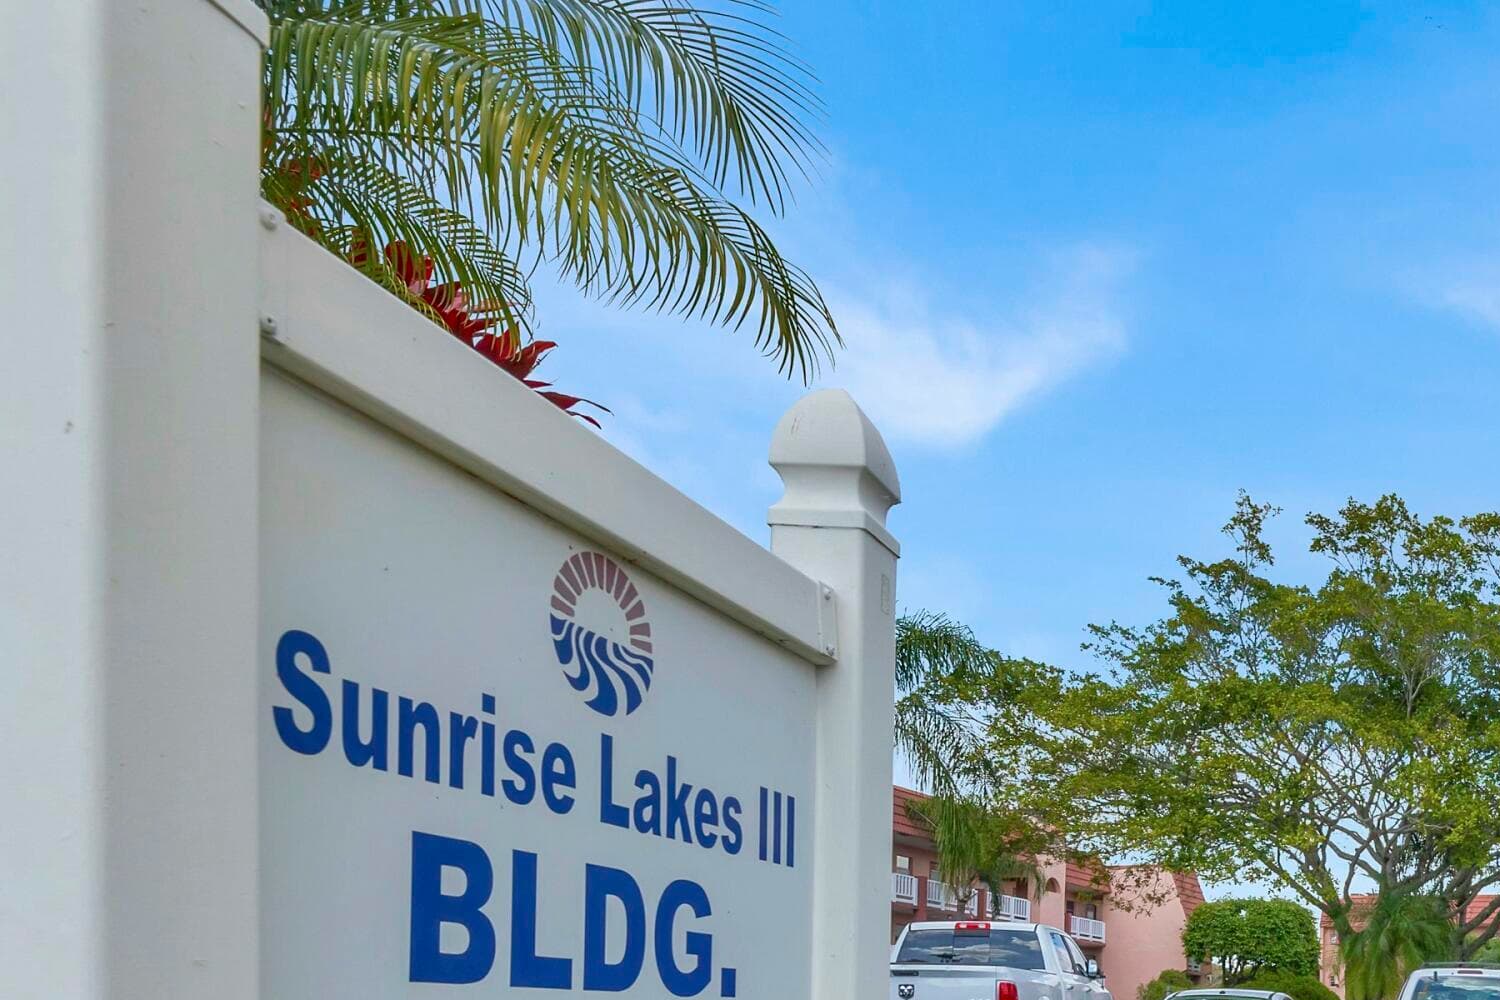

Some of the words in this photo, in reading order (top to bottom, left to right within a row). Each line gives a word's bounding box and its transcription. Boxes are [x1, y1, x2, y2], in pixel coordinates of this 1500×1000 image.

[272, 629, 577, 816] Sunrise
[599, 733, 743, 857] Lakes
[757, 786, 798, 870] III
[405, 831, 737, 999] BLDG.
